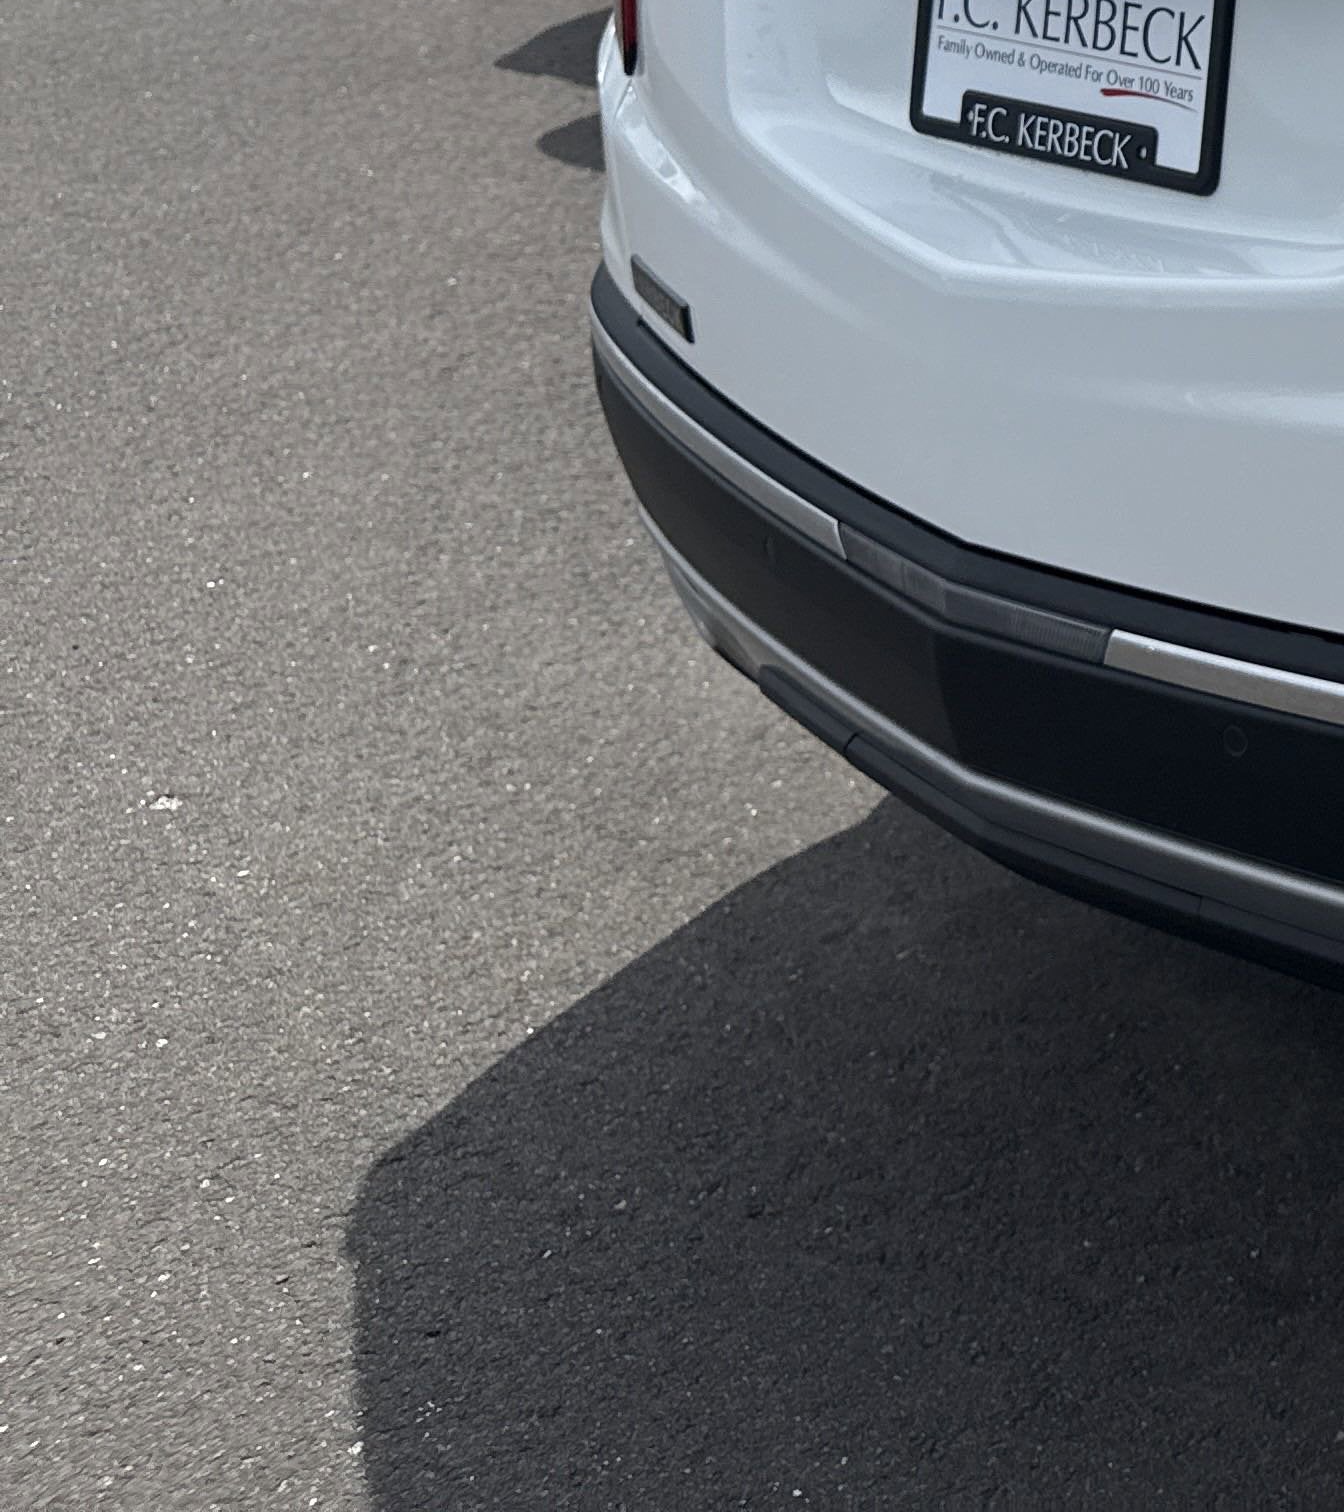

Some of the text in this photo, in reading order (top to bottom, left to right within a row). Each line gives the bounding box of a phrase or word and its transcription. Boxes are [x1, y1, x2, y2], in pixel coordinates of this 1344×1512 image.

[938, 35, 1194, 103] Family Owned & Operated For Over 100 Years
[970, 103, 1132, 169] F.C. KERBECK
